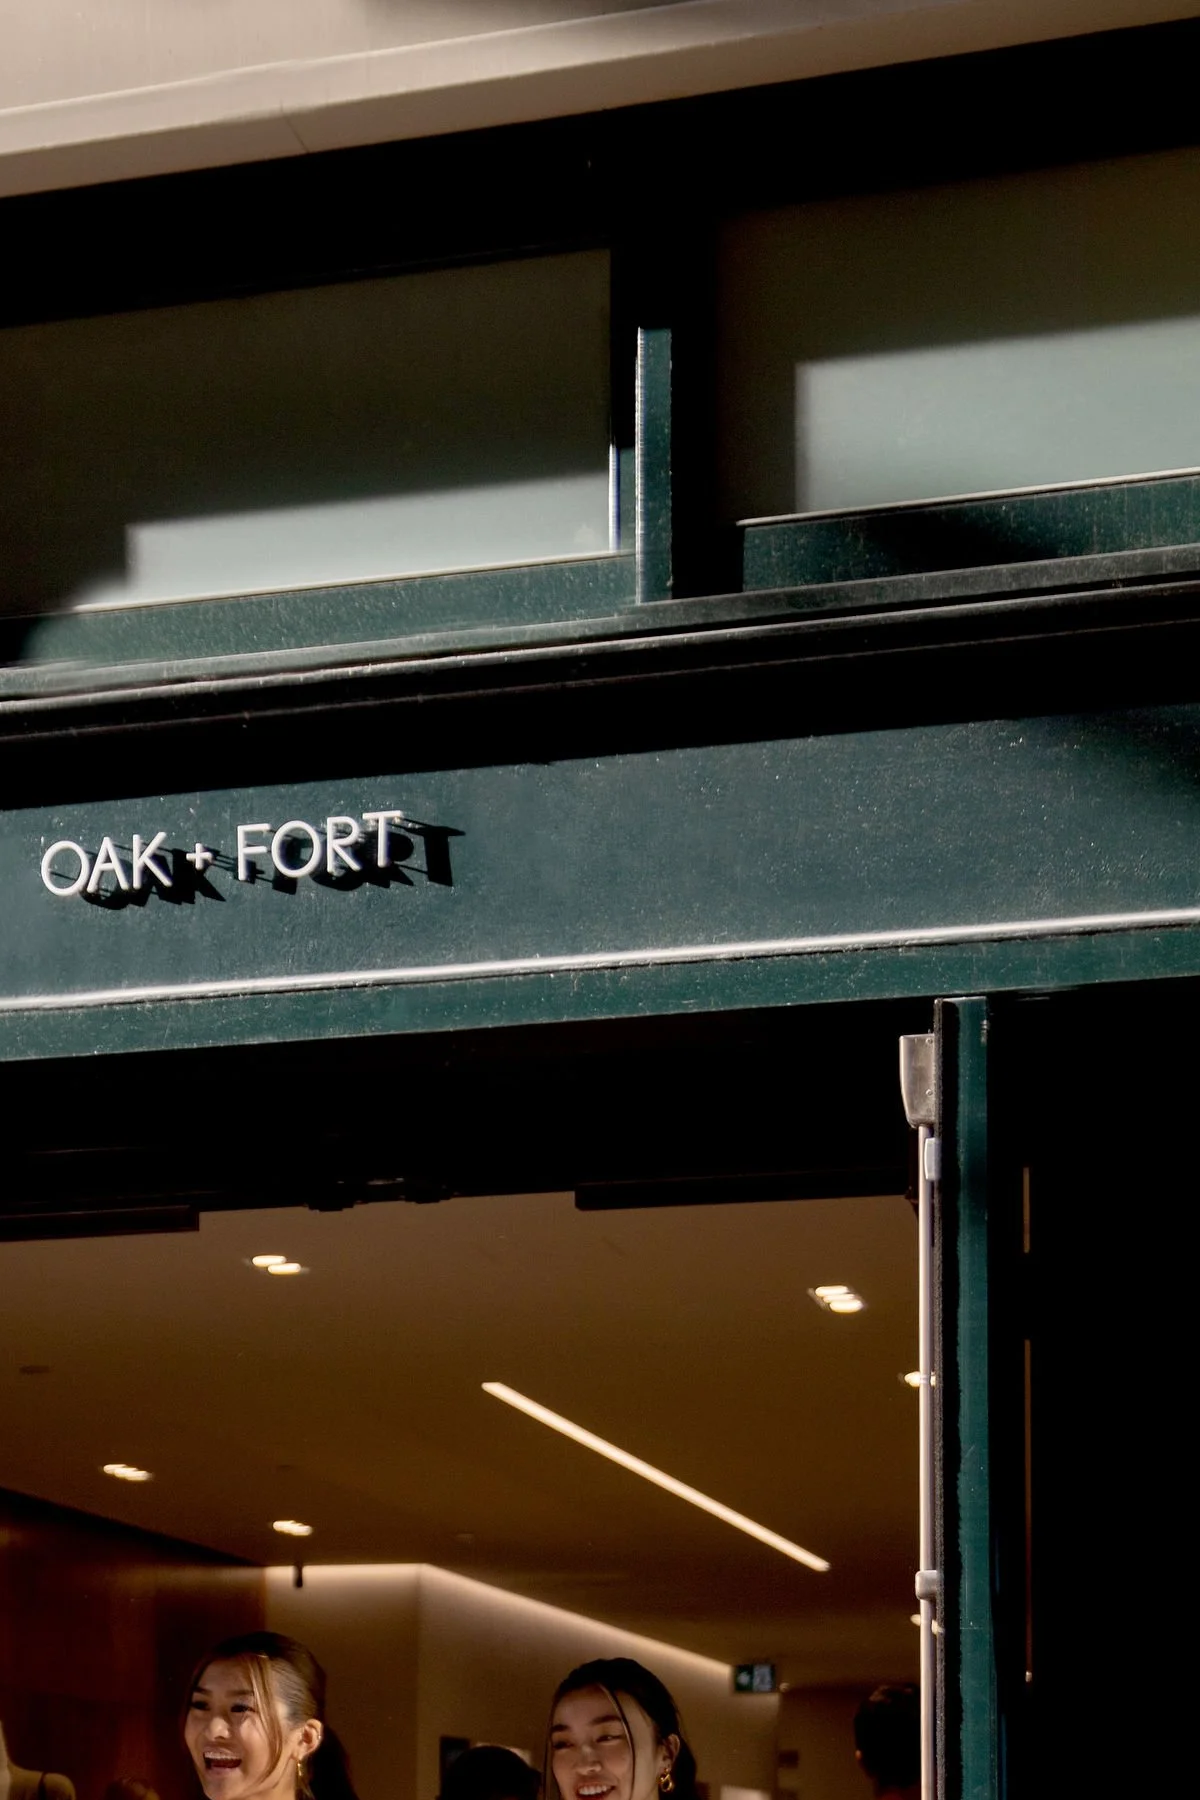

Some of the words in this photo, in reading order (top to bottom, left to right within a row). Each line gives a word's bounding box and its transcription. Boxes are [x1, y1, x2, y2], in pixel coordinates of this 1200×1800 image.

[41, 832, 172, 897] OAK
[187, 843, 212, 870] +
[237, 810, 403, 881] FORT
